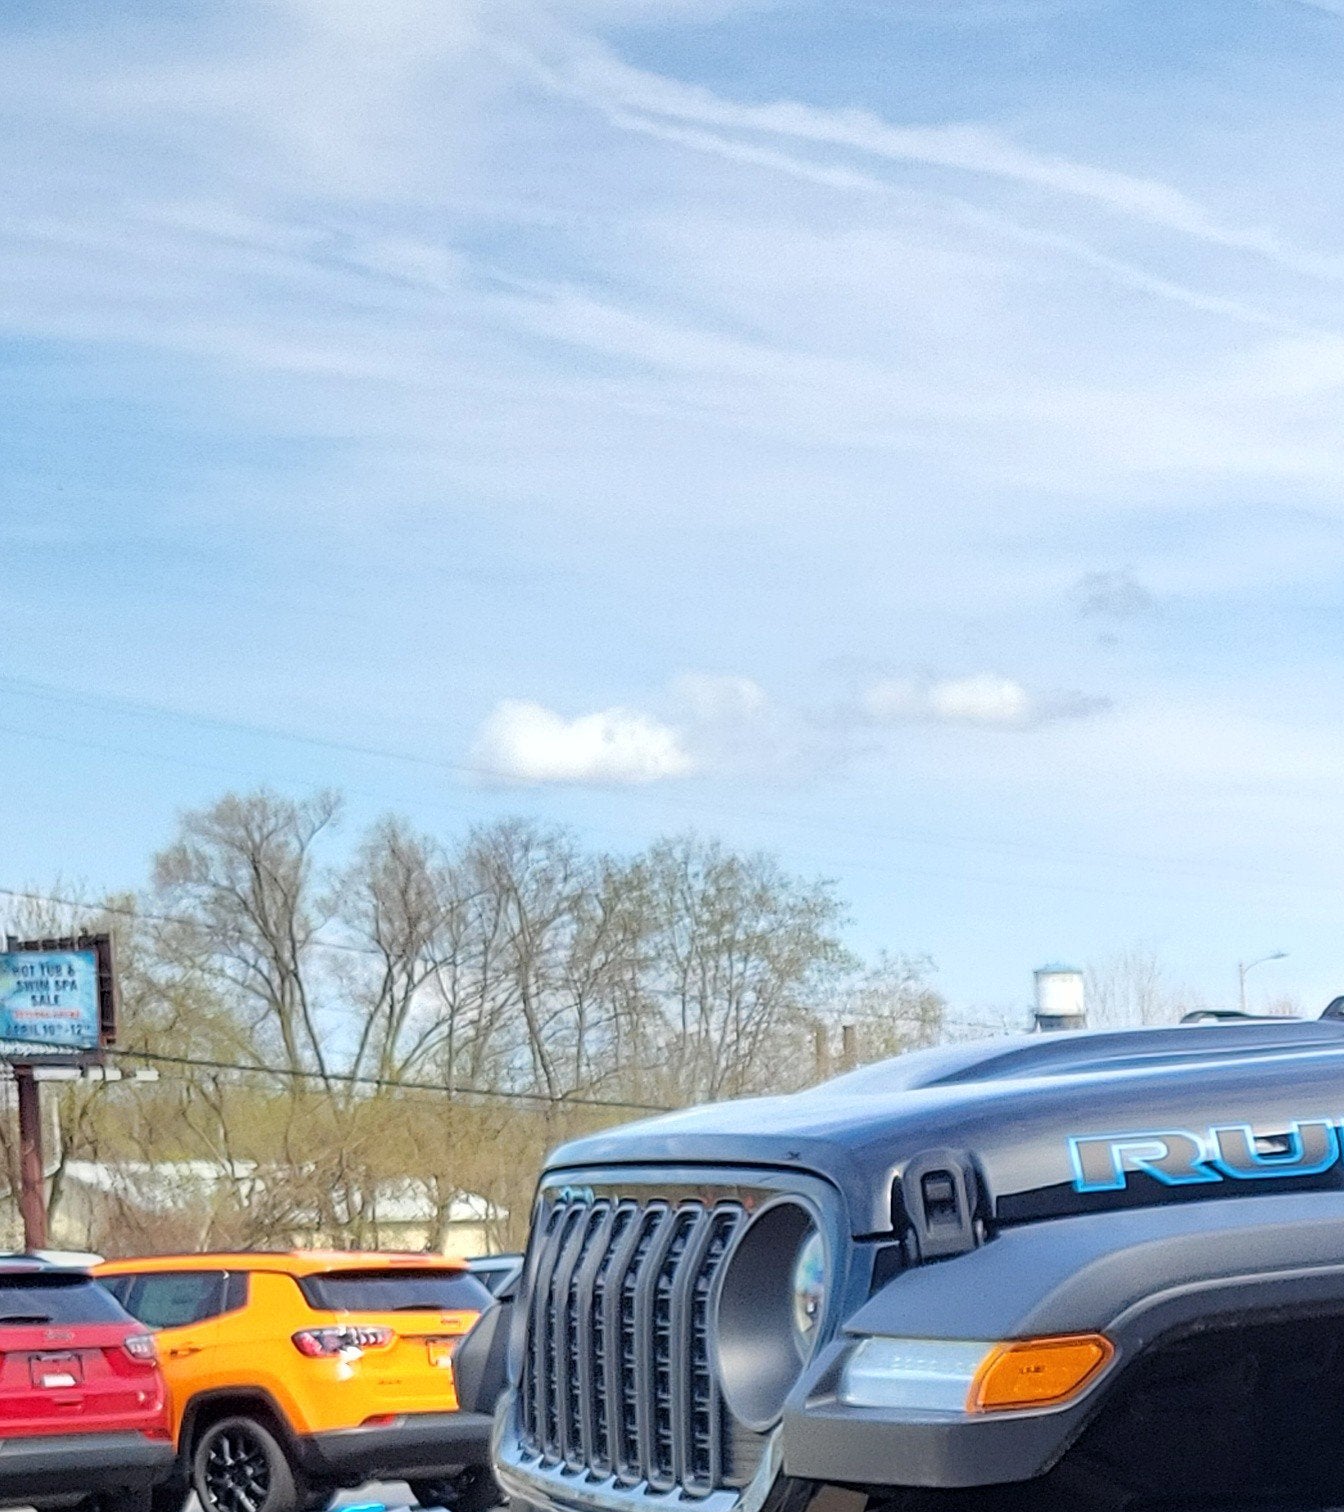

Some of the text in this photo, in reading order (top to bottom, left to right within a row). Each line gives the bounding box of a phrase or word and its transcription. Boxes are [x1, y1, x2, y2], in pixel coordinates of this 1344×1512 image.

[40, 962, 62, 977] TUB
[16, 979, 78, 992] SWIM SPA
[31, 994, 60, 1006] SALE
